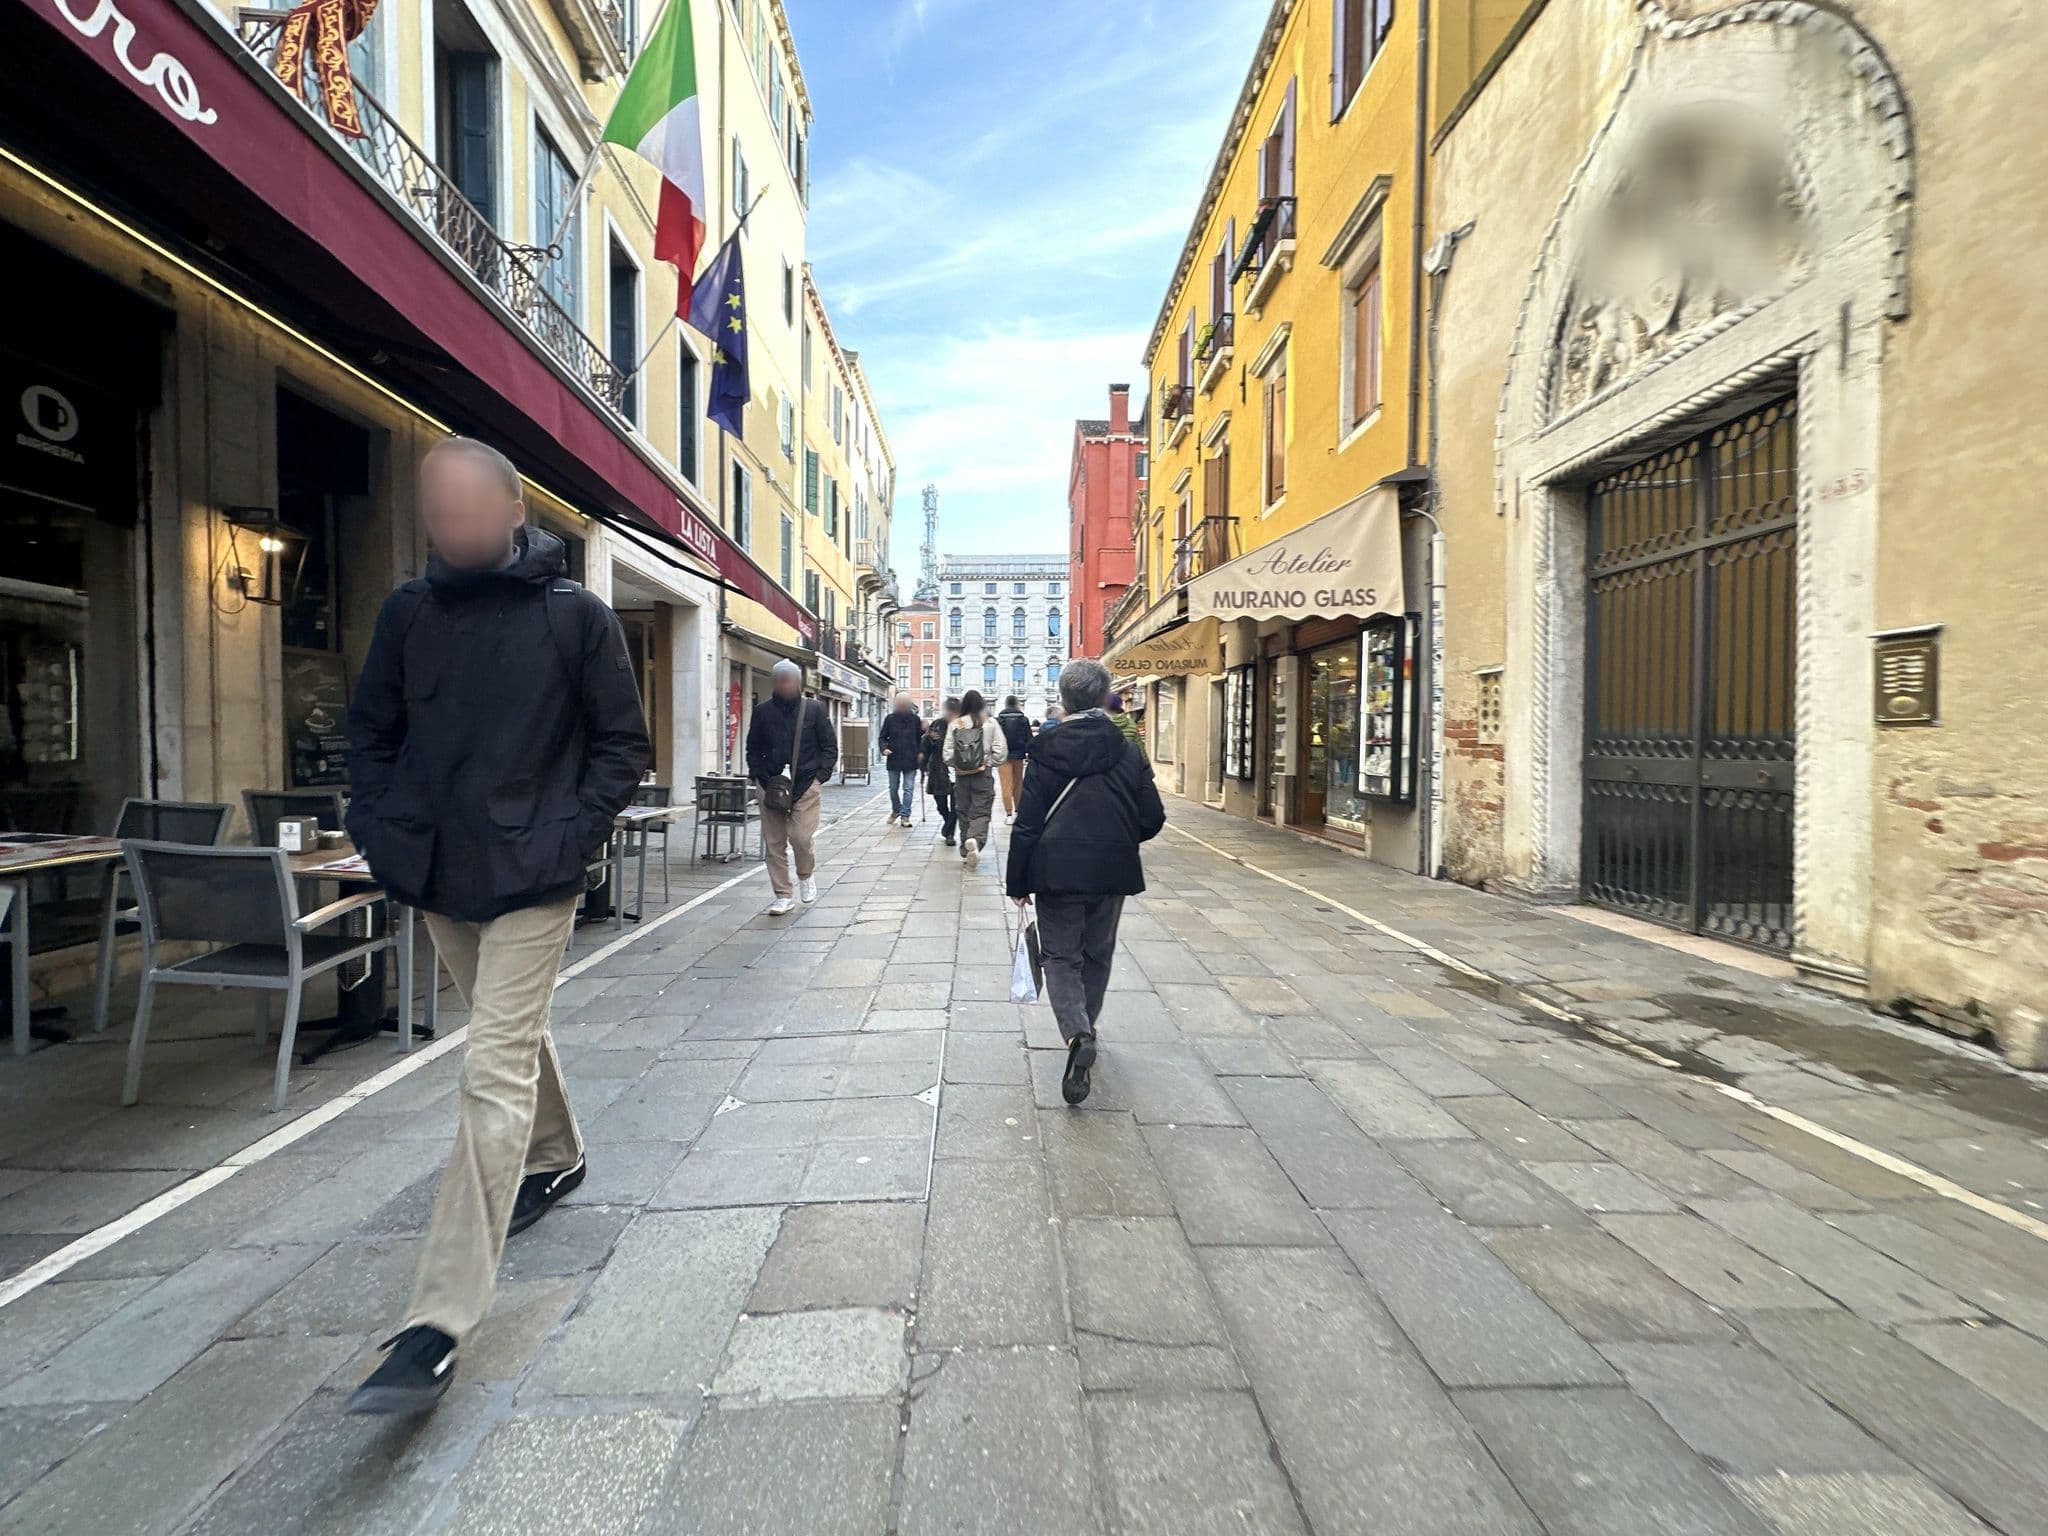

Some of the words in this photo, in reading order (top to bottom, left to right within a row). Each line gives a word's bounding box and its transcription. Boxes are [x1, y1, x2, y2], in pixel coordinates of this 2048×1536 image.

[16, 433, 85, 464] BIRRERIA
[681, 511, 693, 541] LA
[694, 523, 717, 561] LISTA
[1247, 546, 1352, 576] Atelier
[1213, 590, 1306, 609] MURANO
[1314, 588, 1377, 607] GLASS
